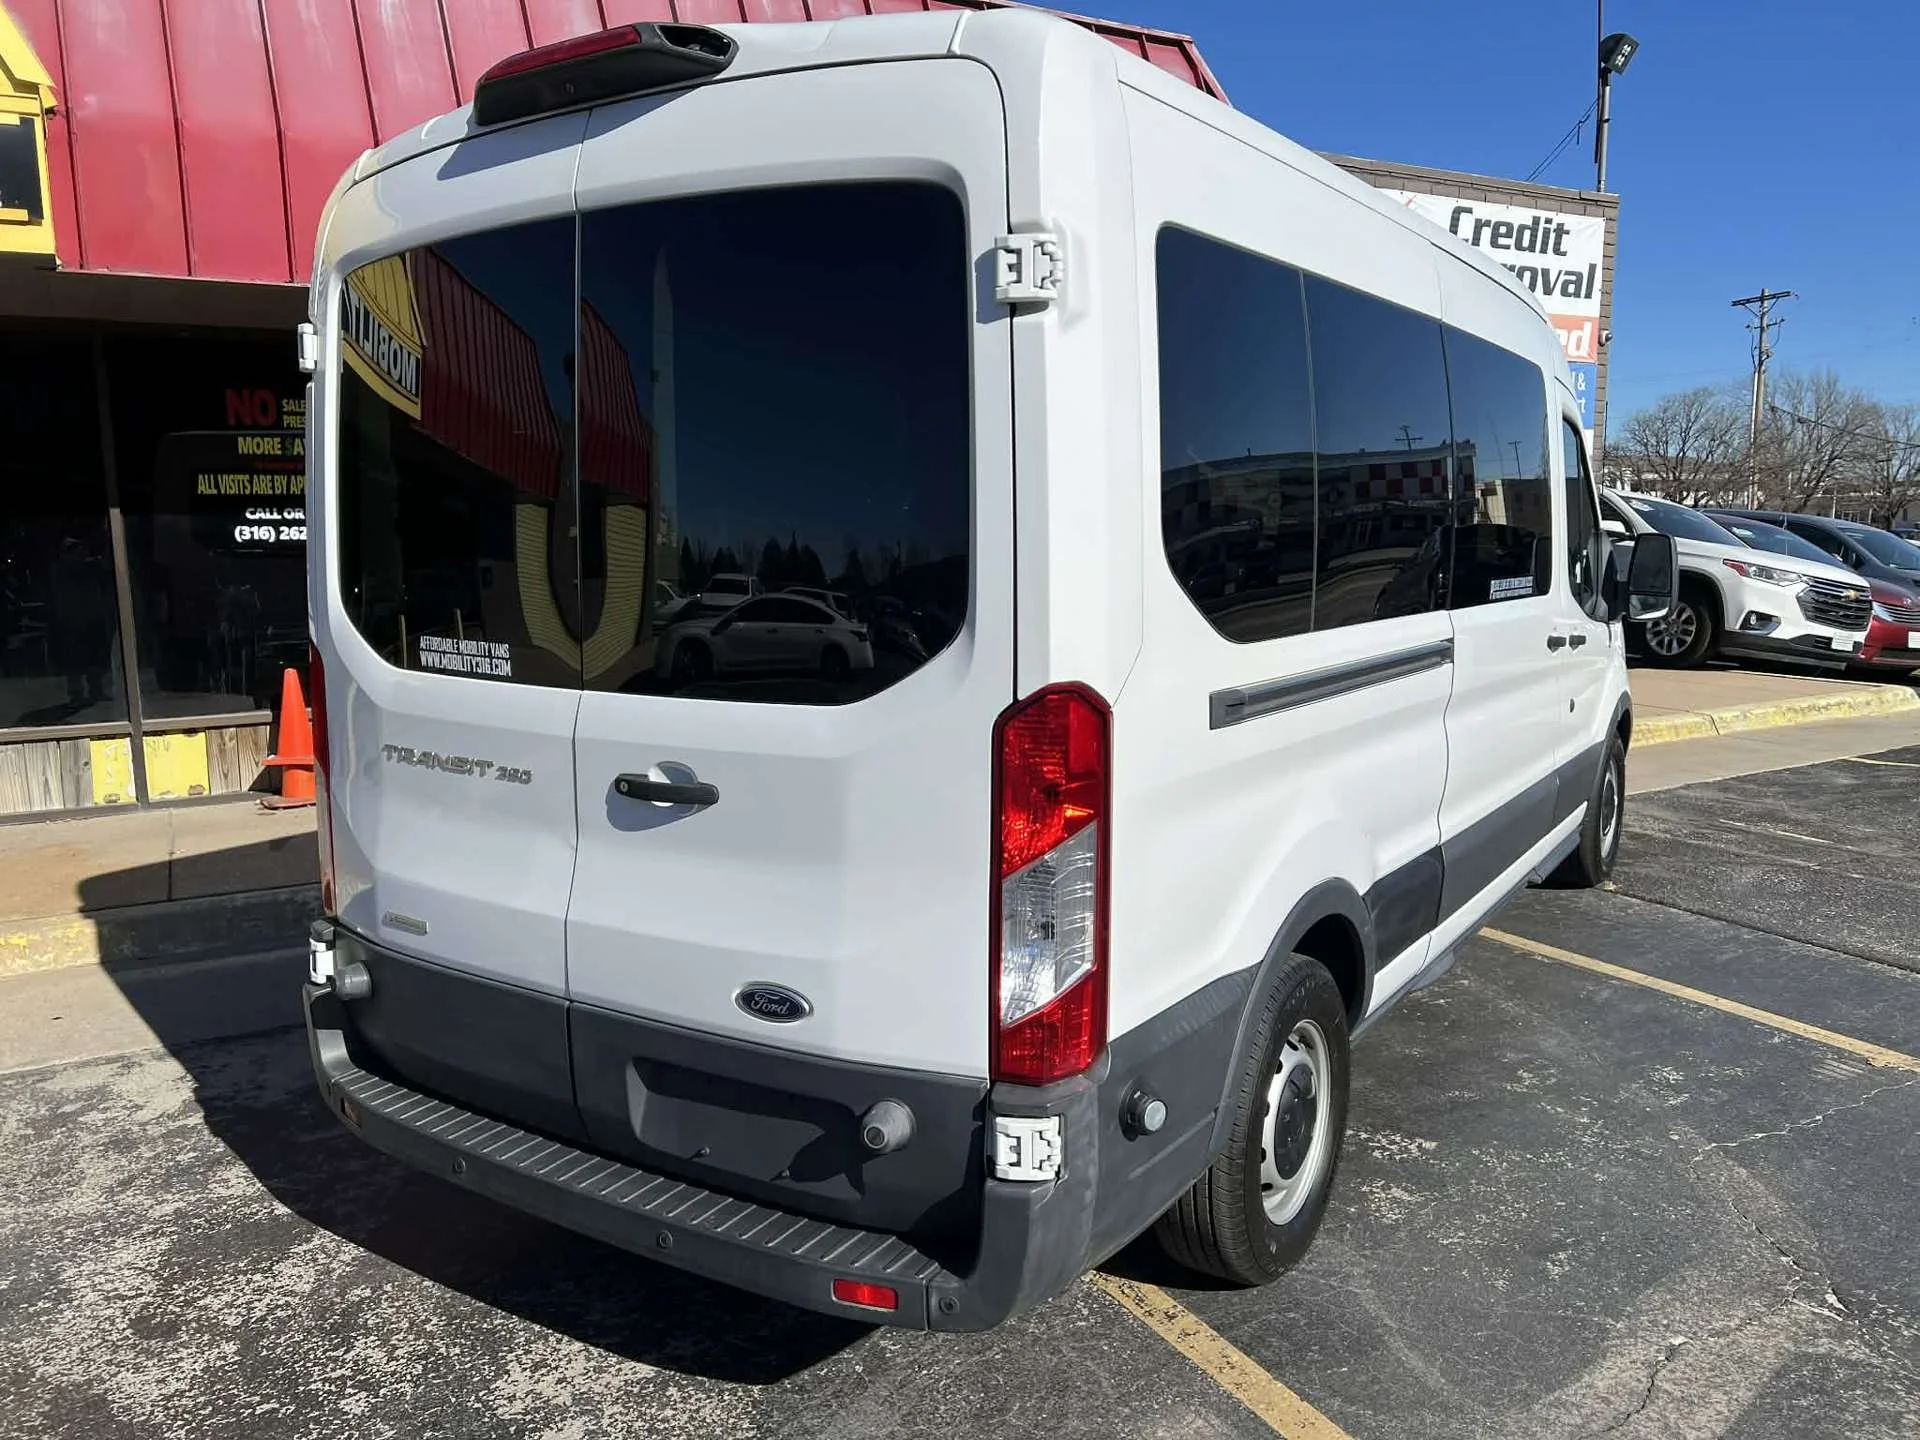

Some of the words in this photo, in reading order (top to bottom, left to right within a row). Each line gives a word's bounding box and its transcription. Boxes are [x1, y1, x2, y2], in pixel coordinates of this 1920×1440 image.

[1449, 206, 1571, 257] Credit
[225, 388, 277, 427] NO
[237, 437, 281, 455] MORE
[198, 474, 218, 494] ALL
[218, 474, 250, 494] VISITS
[252, 475, 273, 494] ARE
[274, 475, 288, 494] BY
[245, 508, 281, 520] CALL
[234, 525, 276, 542] (316)
[279, 526, 307, 540] 262
[420, 635, 458, 653] AFFORDABLE
[459, 640, 489, 656] MOBILITY
[490, 643, 510, 658] VANS
[420, 651, 512, 676] WWW.MOBILITY316.COM
[381, 743, 495, 778] TRANSIT
[750, 992, 790, 1015] Ford
